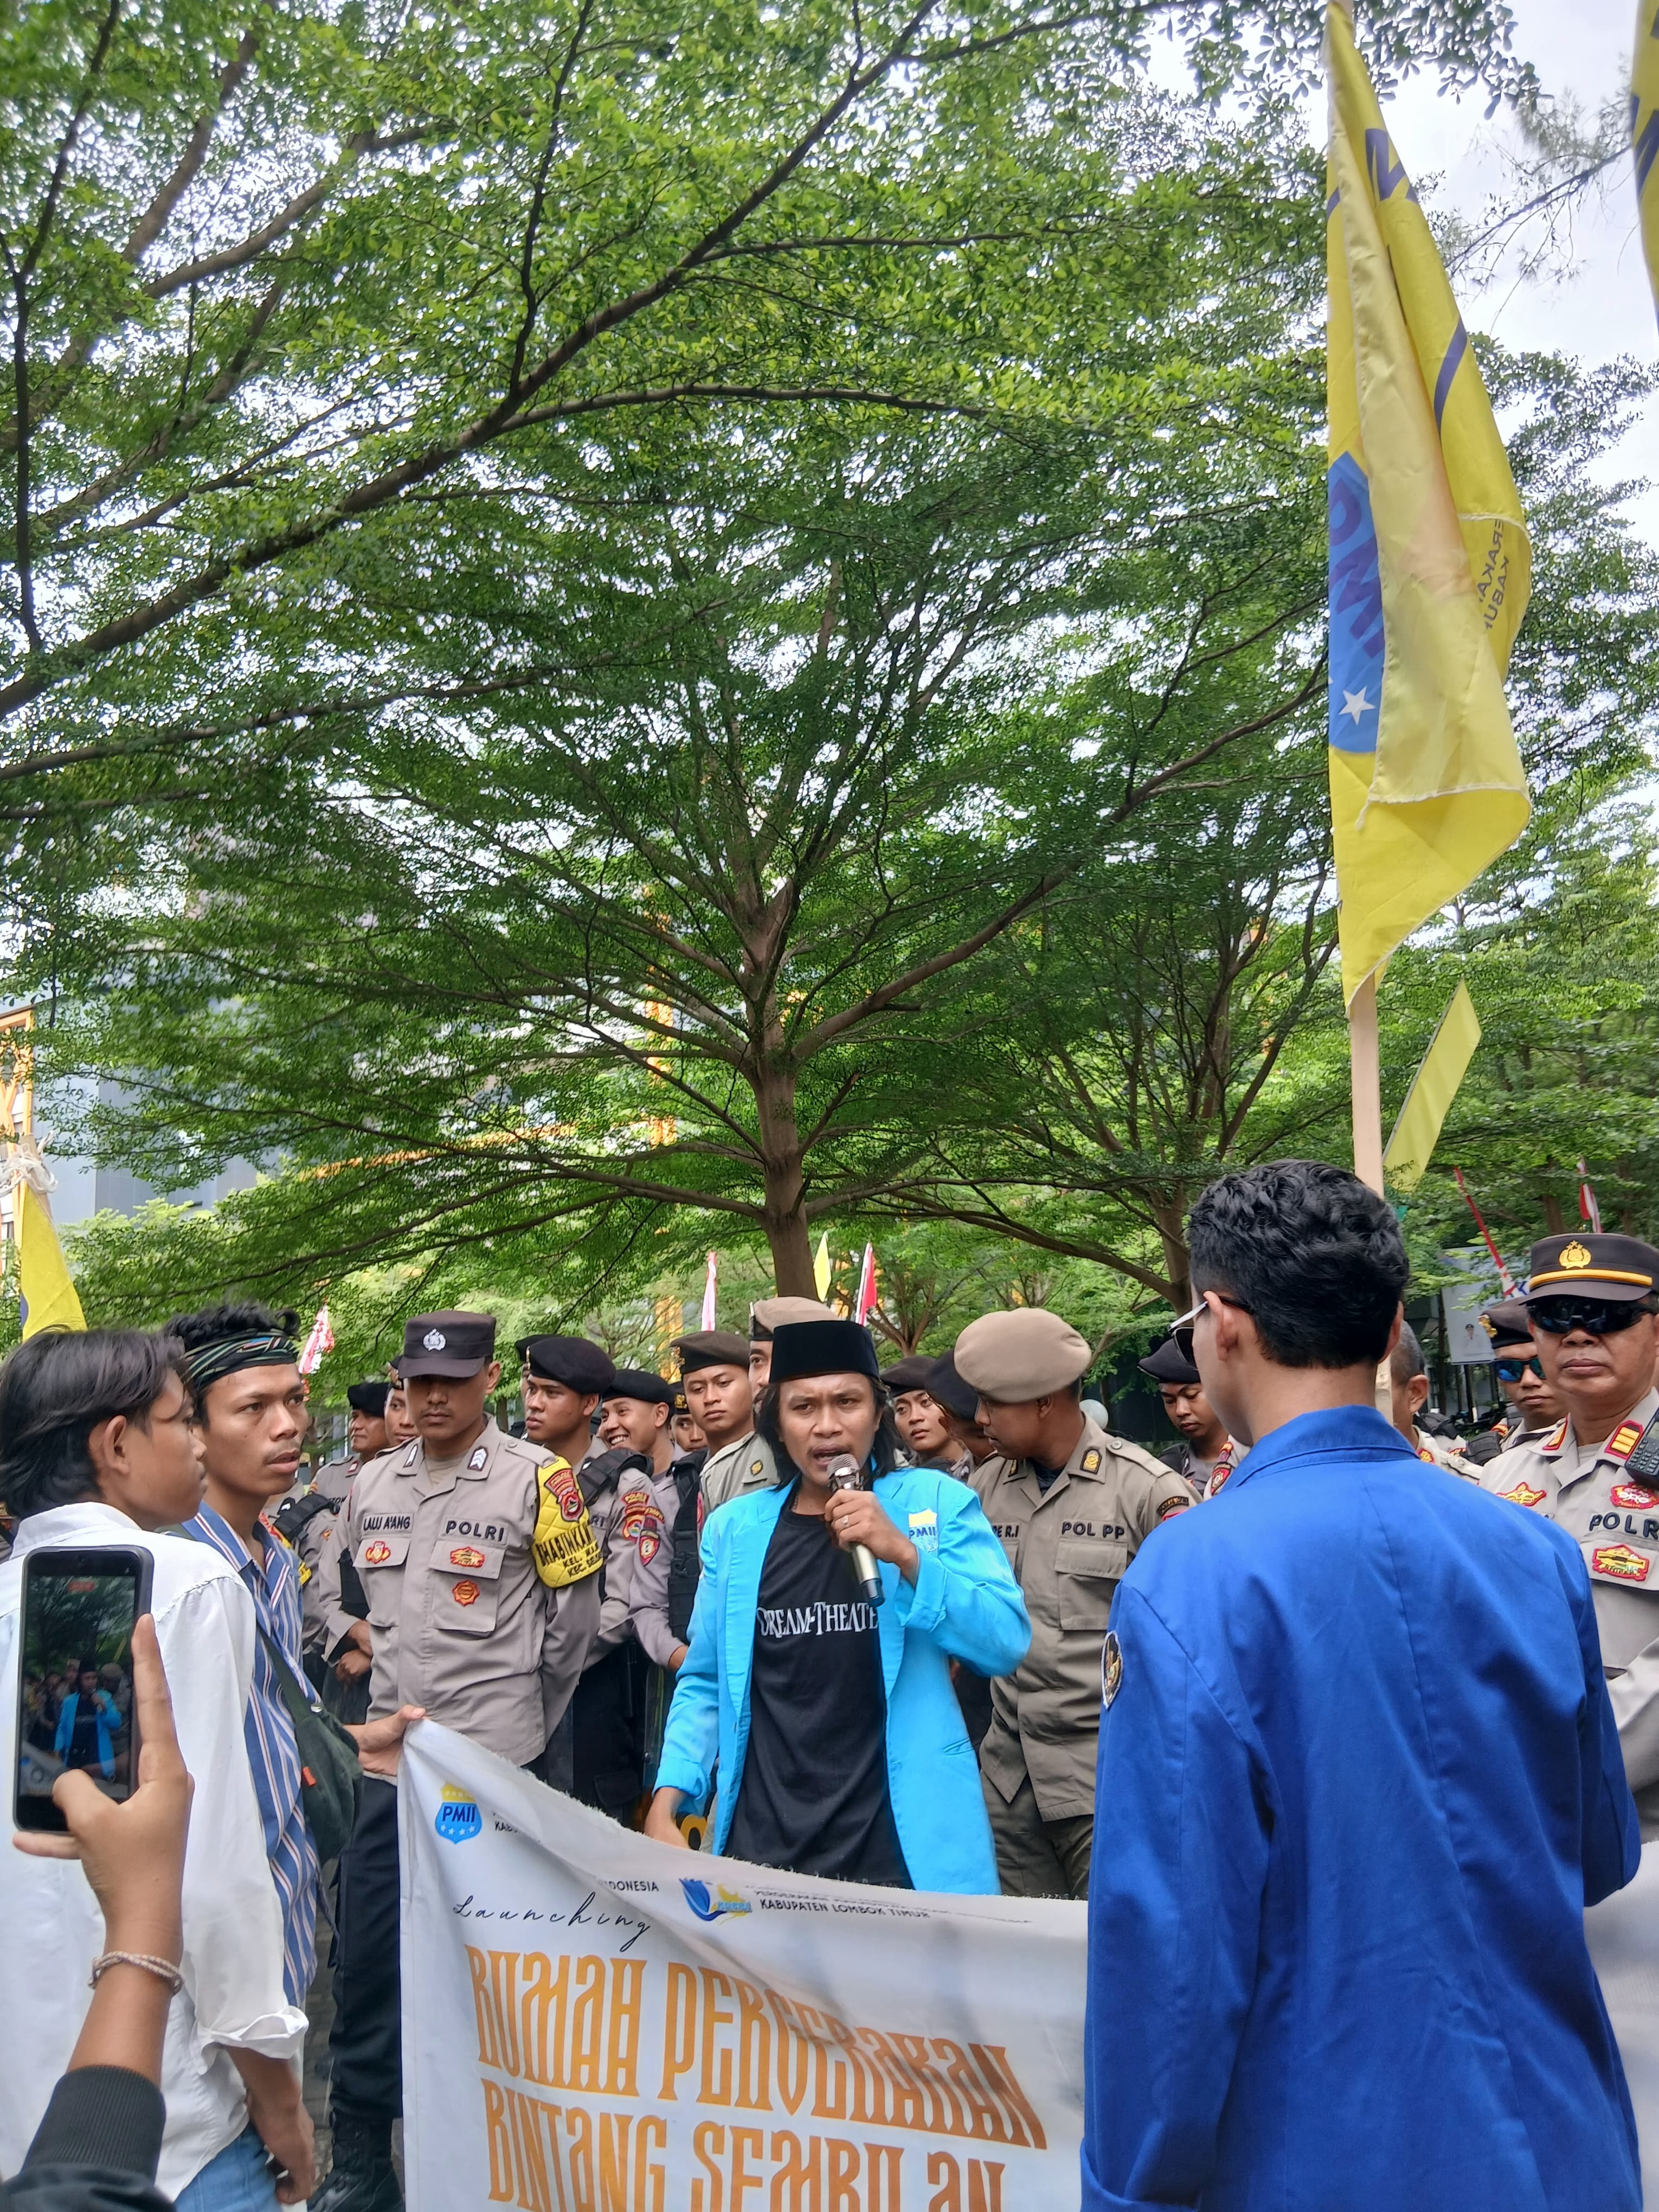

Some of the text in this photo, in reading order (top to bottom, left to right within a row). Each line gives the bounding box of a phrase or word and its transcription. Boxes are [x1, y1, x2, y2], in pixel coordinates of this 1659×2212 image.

[446, 1520, 505, 1542] POLRI
[909, 1526, 936, 1540] PMII
[1061, 1521, 1124, 1539] POL PP
[1589, 1512, 1659, 1540] POLR
[756, 1606, 812, 1638] DREAM
[442, 1805, 476, 1823] PMII
[603, 1880, 659, 1892] DONESIA
[760, 1898, 828, 1912] KABUPATEN
[453, 1892, 651, 1953] Launching
[465, 1945, 1047, 2150] RUMAH PERGERAKAN
[480, 2077, 666, 2212] BINTANG
